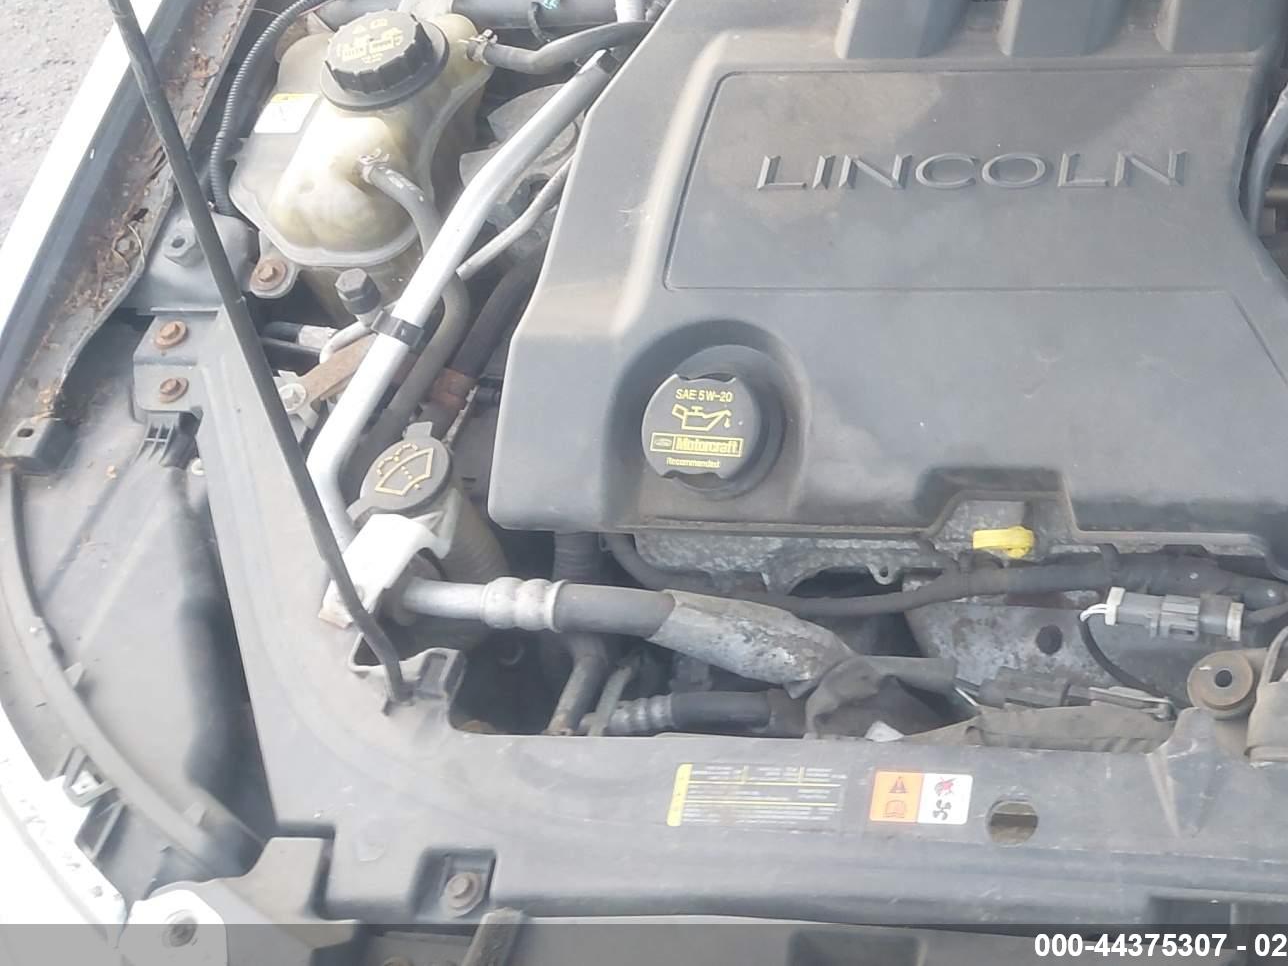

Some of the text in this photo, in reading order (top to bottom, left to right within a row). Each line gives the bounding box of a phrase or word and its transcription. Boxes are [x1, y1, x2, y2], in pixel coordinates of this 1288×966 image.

[756, 149, 1188, 190] LINCOLN
[675, 388, 734, 403] SAE 5W-20
[675, 437, 738, 454] Motorcraft
[666, 457, 721, 468] Recommended
